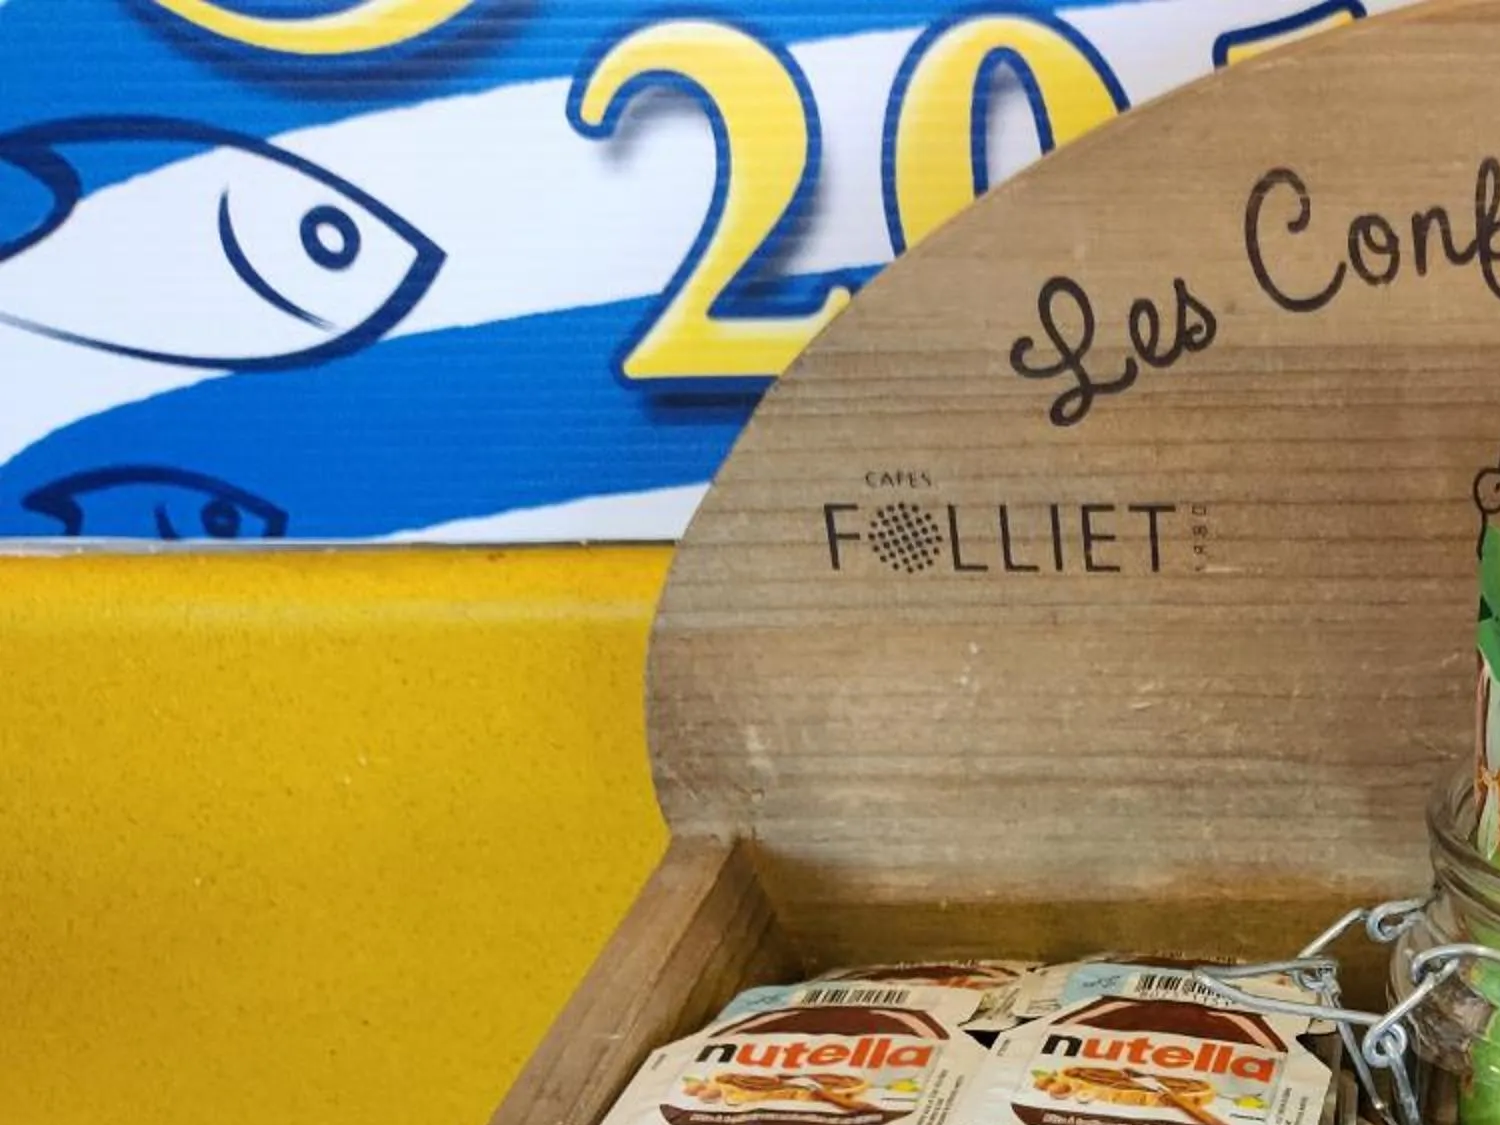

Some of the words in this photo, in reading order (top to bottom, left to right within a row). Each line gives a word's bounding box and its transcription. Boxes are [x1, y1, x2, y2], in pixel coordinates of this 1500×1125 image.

[1009, 276, 1217, 427] Les
[823, 503, 1176, 573] FOLLIET
[696, 1037, 934, 1070] nutella
[1041, 1033, 1276, 1084] nutella
